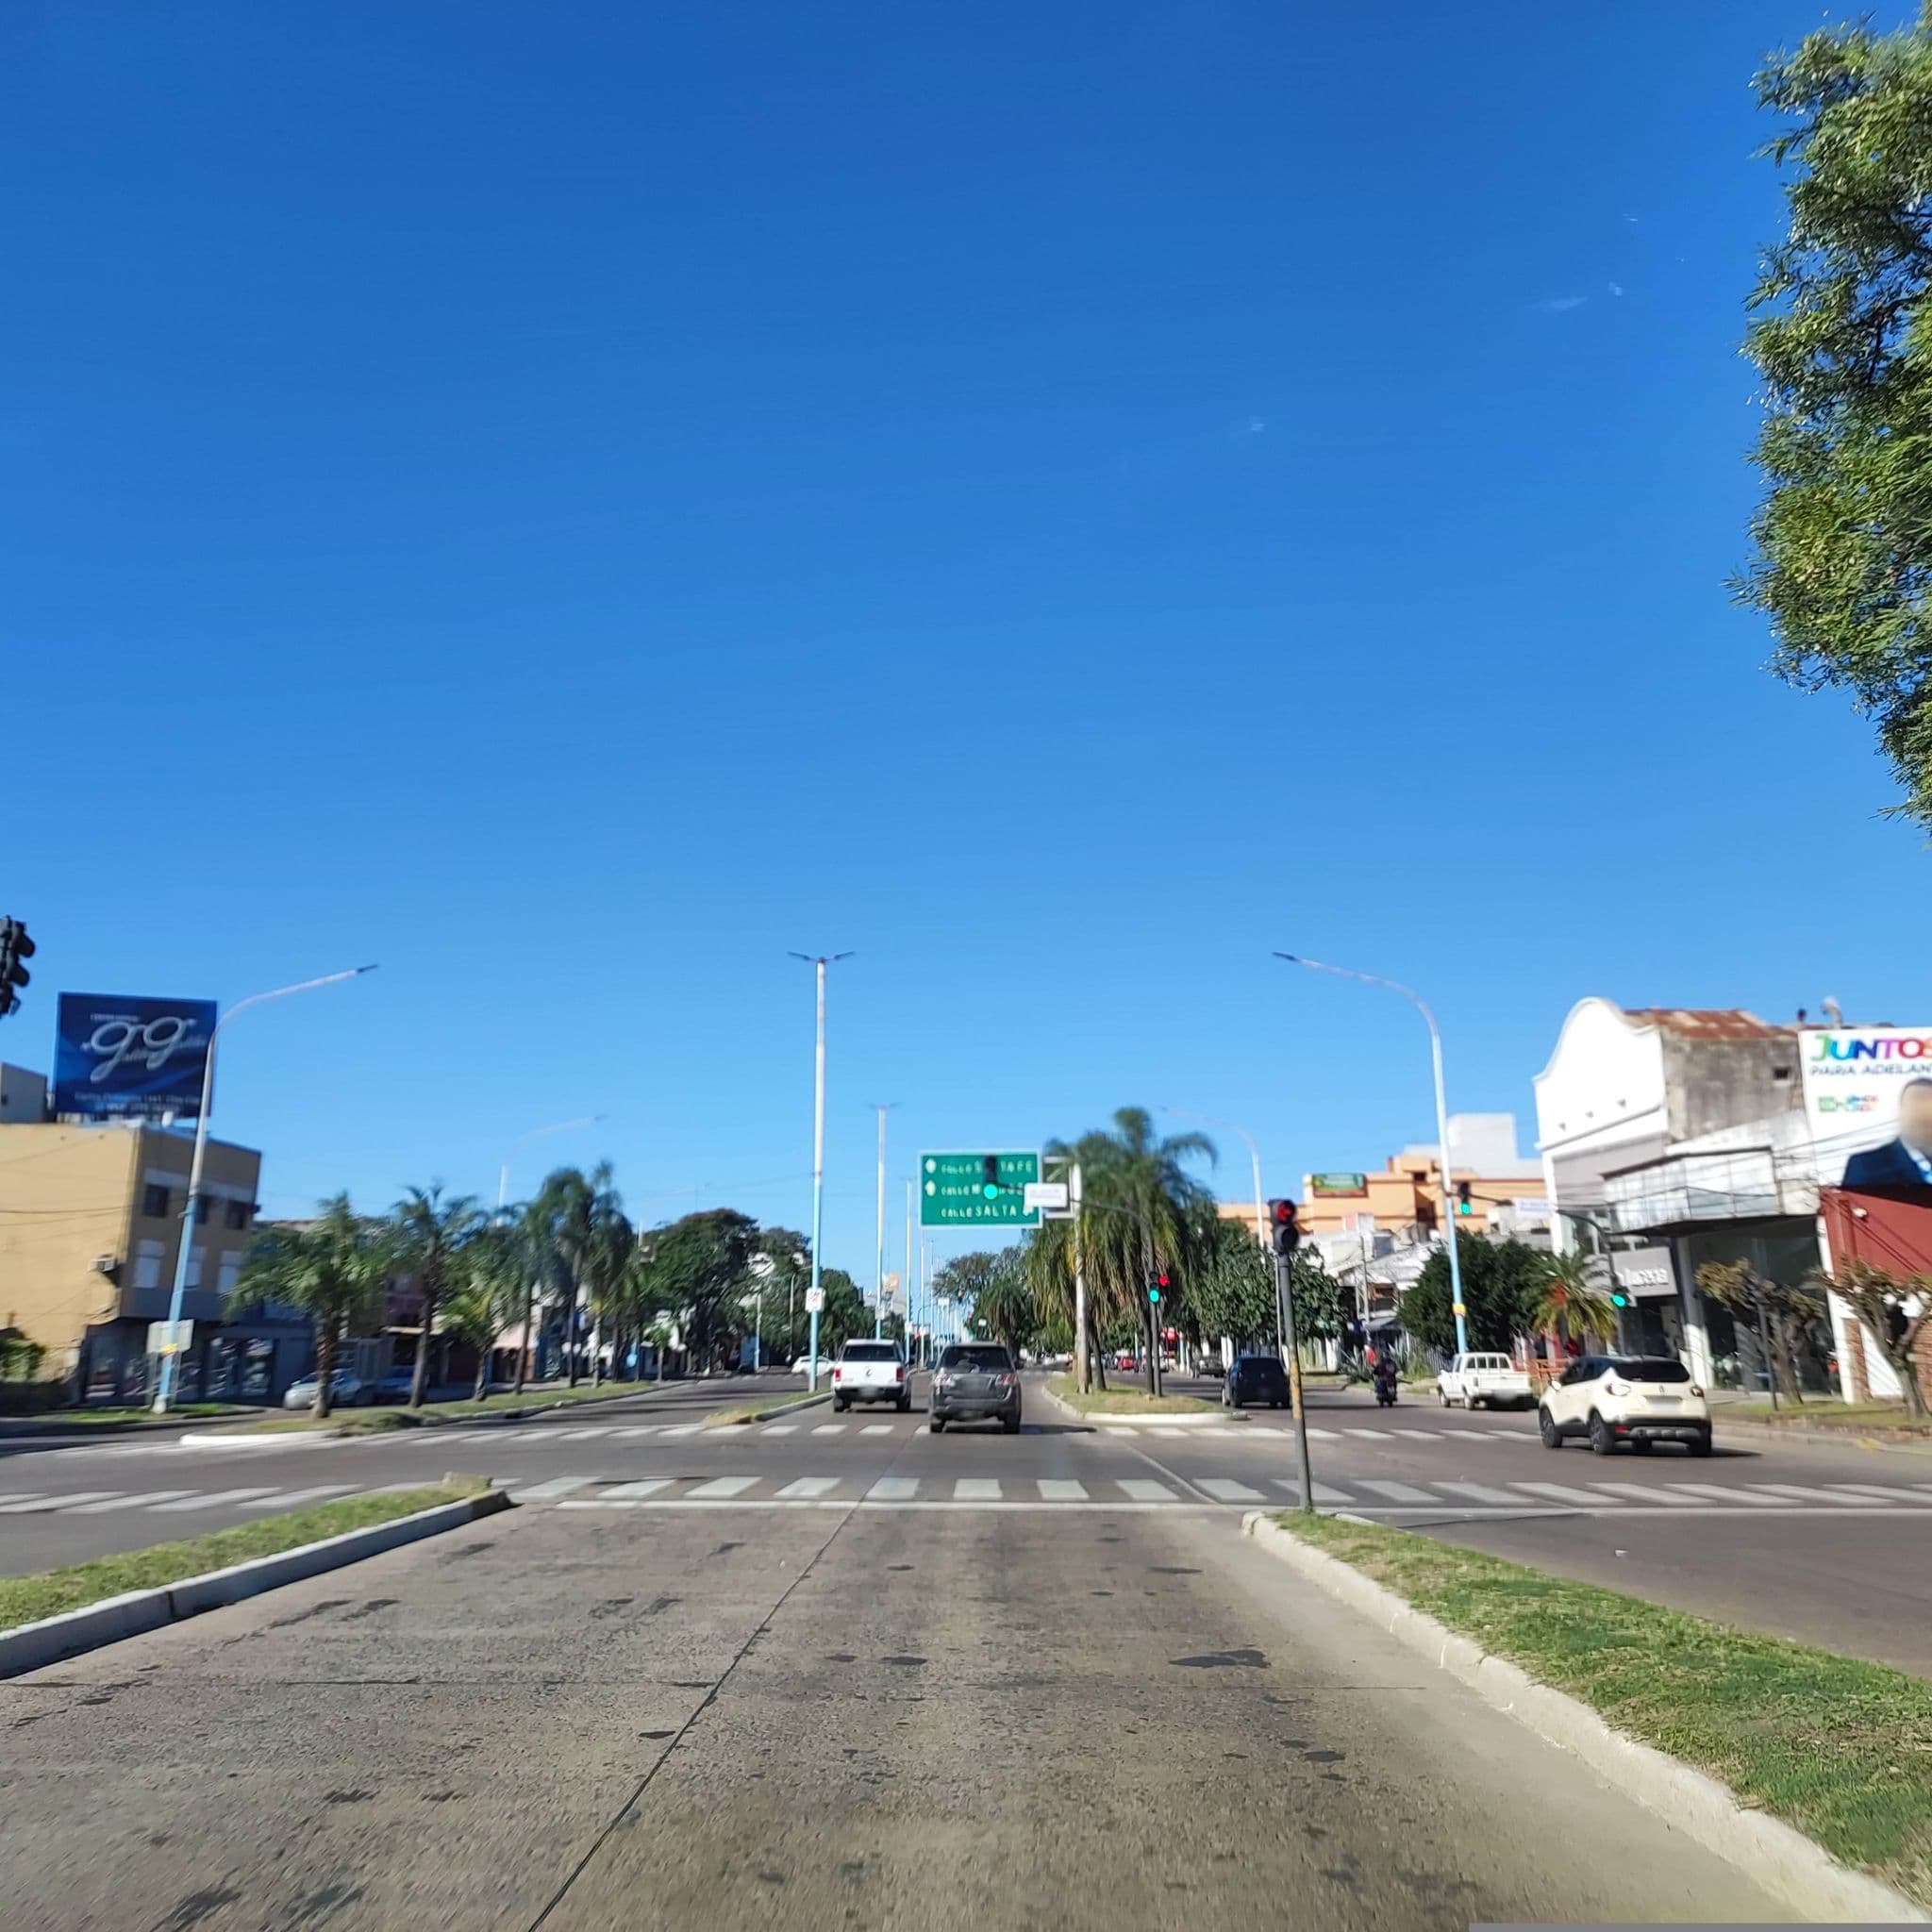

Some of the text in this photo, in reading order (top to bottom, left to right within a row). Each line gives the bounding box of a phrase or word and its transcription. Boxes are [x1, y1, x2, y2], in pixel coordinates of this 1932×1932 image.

[1809, 1062, 1932, 1075] PARA ADELAN
[941, 1185, 970, 1196] CALLE
[941, 1205, 1017, 1218] CALLE SALTA
